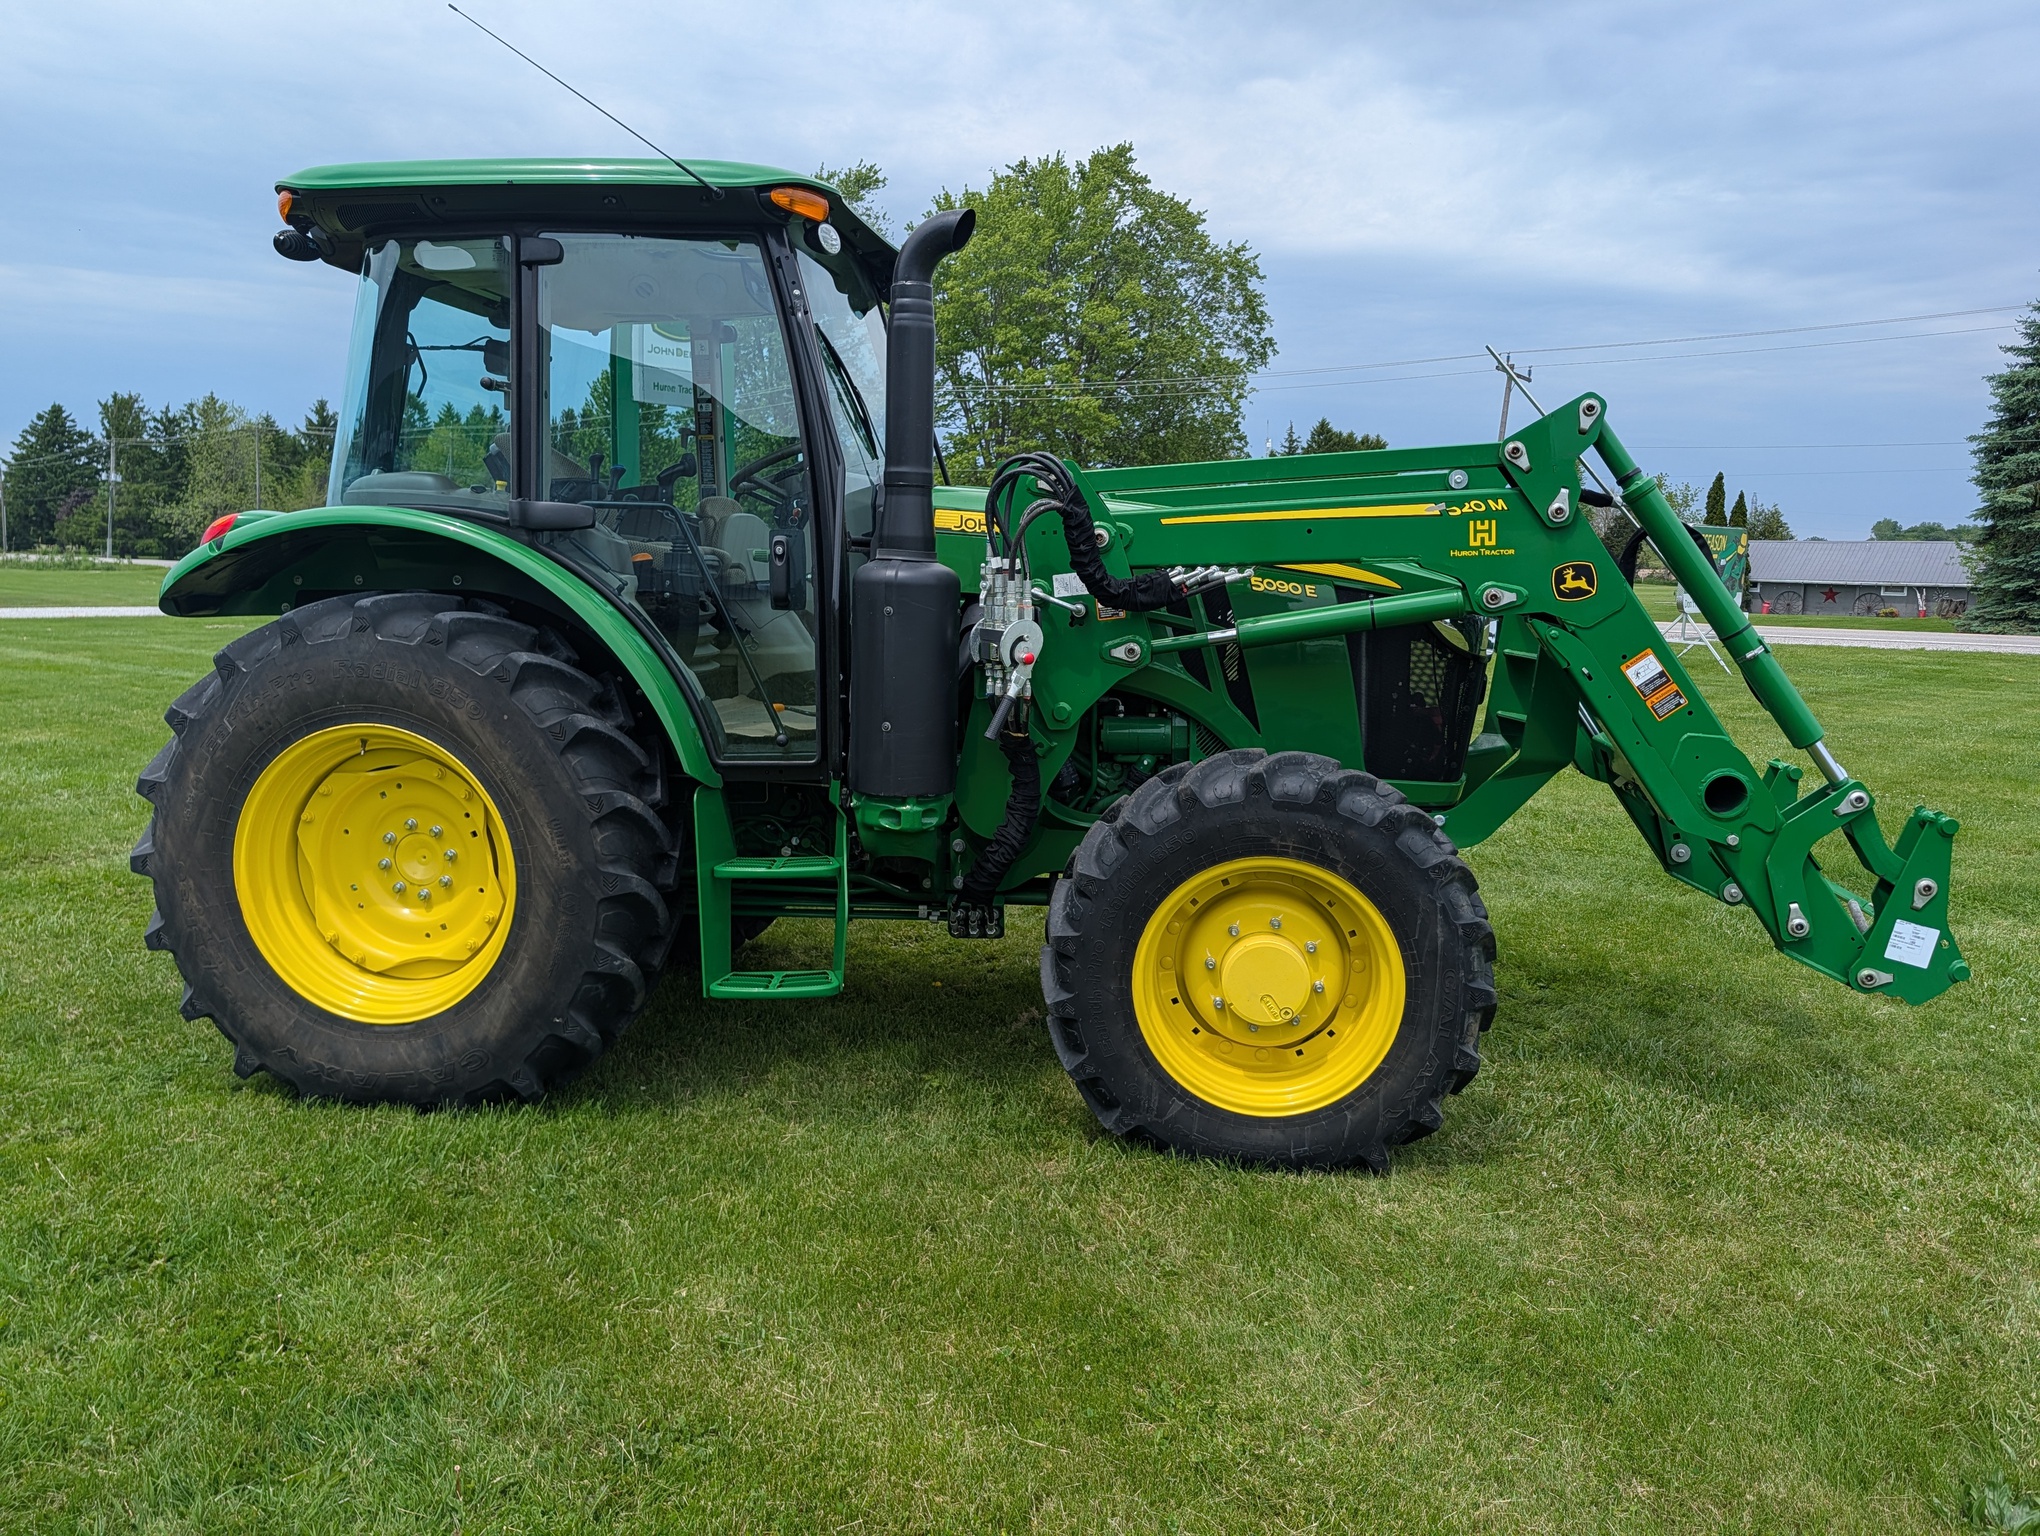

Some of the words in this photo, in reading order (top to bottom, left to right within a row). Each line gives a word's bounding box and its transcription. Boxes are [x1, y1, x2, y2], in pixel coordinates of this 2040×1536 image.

[647, 344, 675, 356] JOHN
[653, 381, 676, 393] Huron
[677, 384, 693, 395] Trac
[1486, 498, 1509, 511] M
[1450, 549, 1478, 557] HURON
[1479, 548, 1515, 556] TRACTOR
[1250, 576, 1303, 595] 5090
[1304, 584, 1318, 598] E
[200, 667, 318, 753] Earth-Pro
[331, 658, 424, 689] Radial
[428, 675, 488, 722] 850
[1098, 860, 1151, 930] Radial
[1149, 827, 1198, 866] 850
